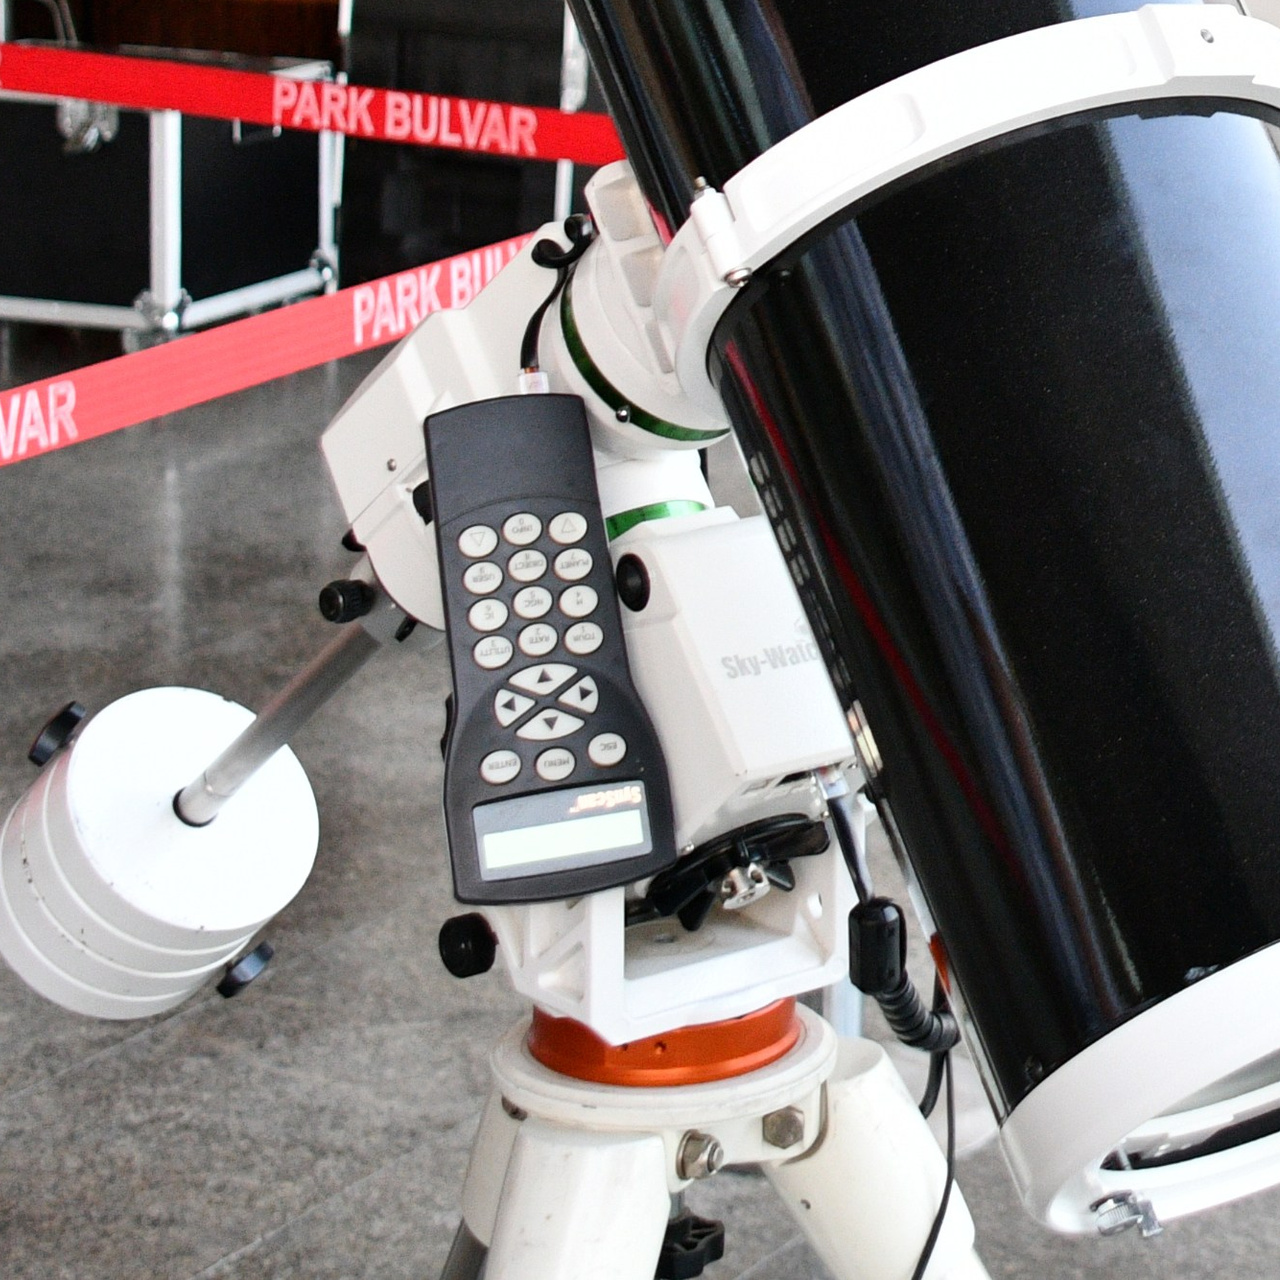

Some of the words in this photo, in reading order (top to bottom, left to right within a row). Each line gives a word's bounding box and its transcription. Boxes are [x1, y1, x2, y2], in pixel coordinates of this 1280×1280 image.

[272, 77, 375, 136] PARK
[385, 90, 538, 156] BULVAR
[353, 264, 442, 346] PARK
[511, 524, 533, 534] INFO
[513, 560, 544, 570] OBJECT
[560, 559, 589, 569] PLANET
[472, 574, 496, 583] USER
[524, 599, 544, 608] NGC
[528, 634, 550, 644] RATE
[573, 632, 595, 642] TOUR
[479, 646, 511, 657] UTILITY
[600, 742, 618, 751] ESC
[488, 758, 517, 770] ENTER
[543, 757, 570, 767] MENU
